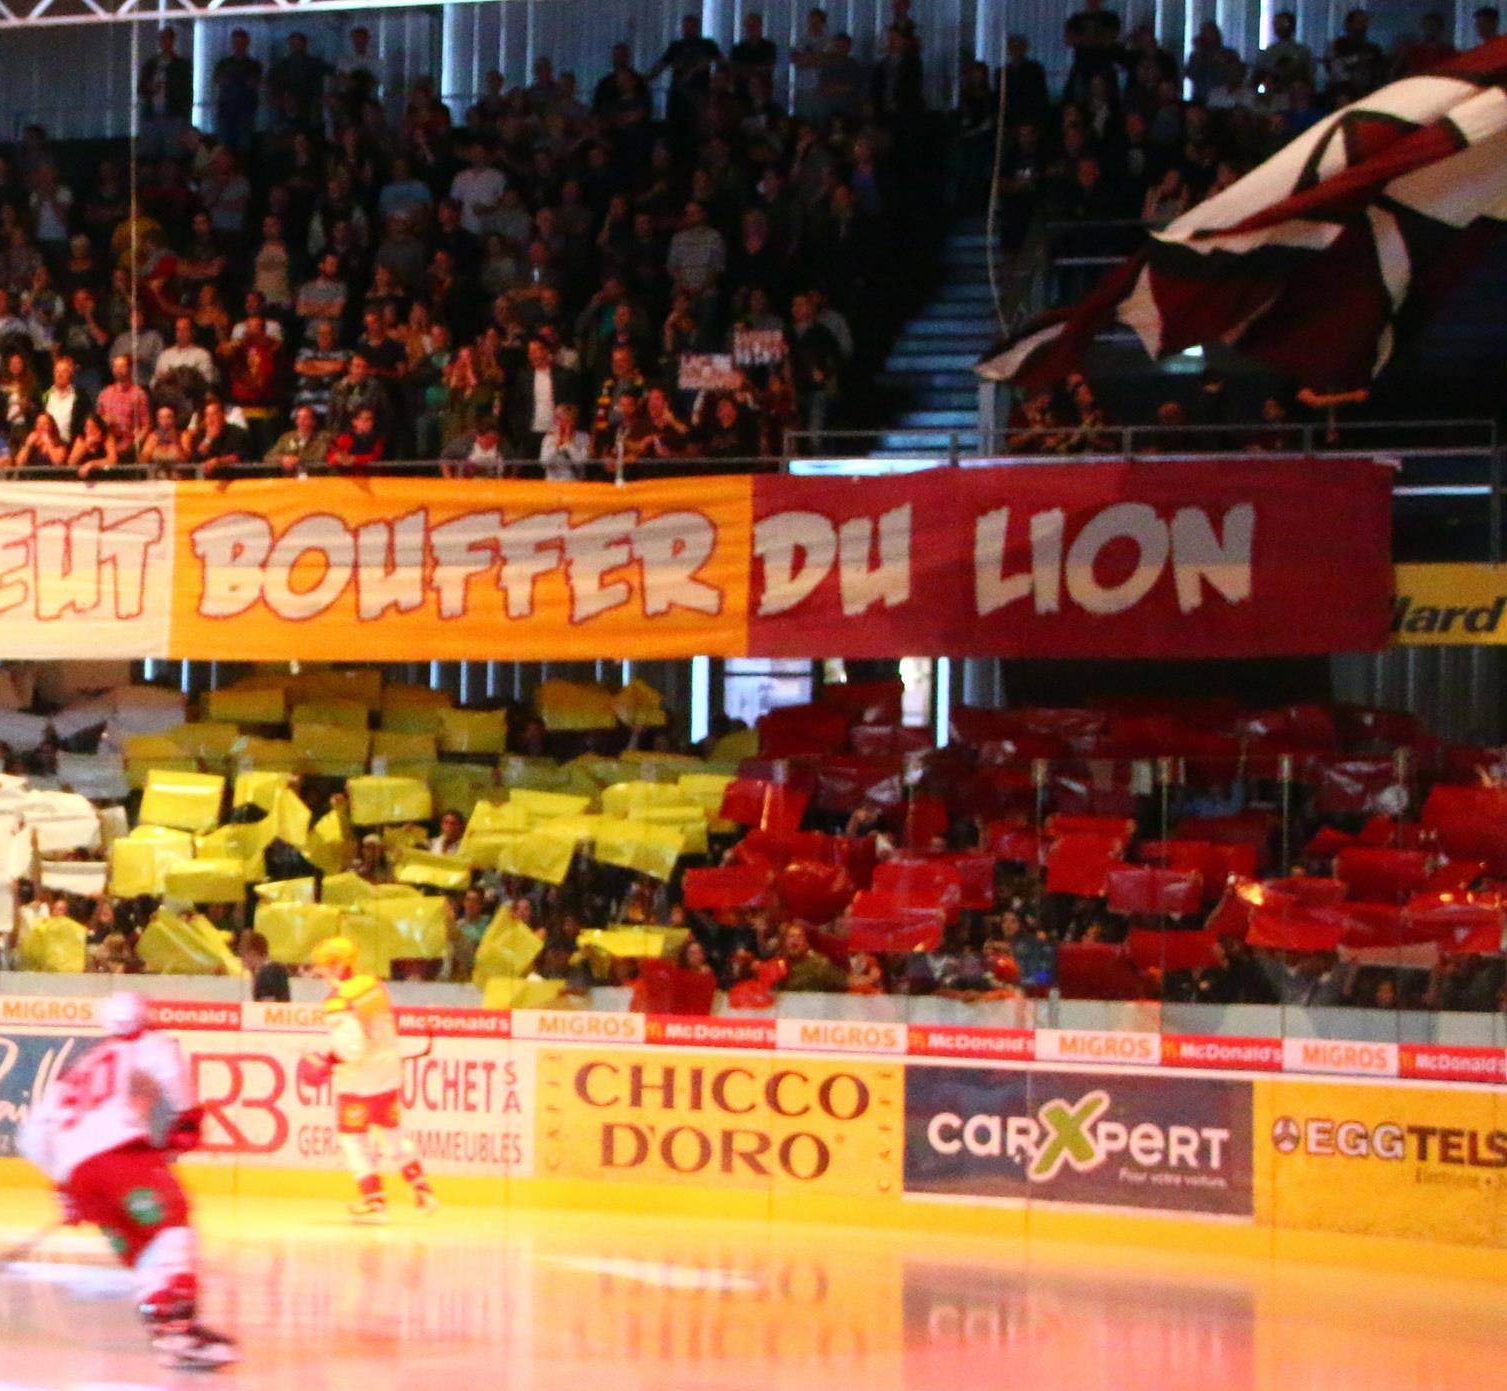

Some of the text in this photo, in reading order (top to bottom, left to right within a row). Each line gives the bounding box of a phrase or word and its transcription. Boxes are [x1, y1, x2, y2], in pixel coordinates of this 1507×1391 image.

[190, 506, 723, 624] BOUFFER
[753, 502, 912, 617] DU
[974, 501, 1256, 615] LION
[1, 1001, 94, 1020] MIGROS
[398, 1014, 509, 1031] McDonald's
[538, 1015, 636, 1037] MIGROS
[665, 1023, 776, 1041] McDonald's
[800, 1025, 897, 1048] MIGROS
[927, 1033, 1034, 1052] McDonald's
[1058, 1036, 1151, 1058] MIGROS
[1180, 1042, 1282, 1062] McDonald's
[1302, 1044, 1387, 1069] MIGROS
[574, 1061, 870, 1121] CHICCO
[601, 1121, 831, 1181] D'ORO
